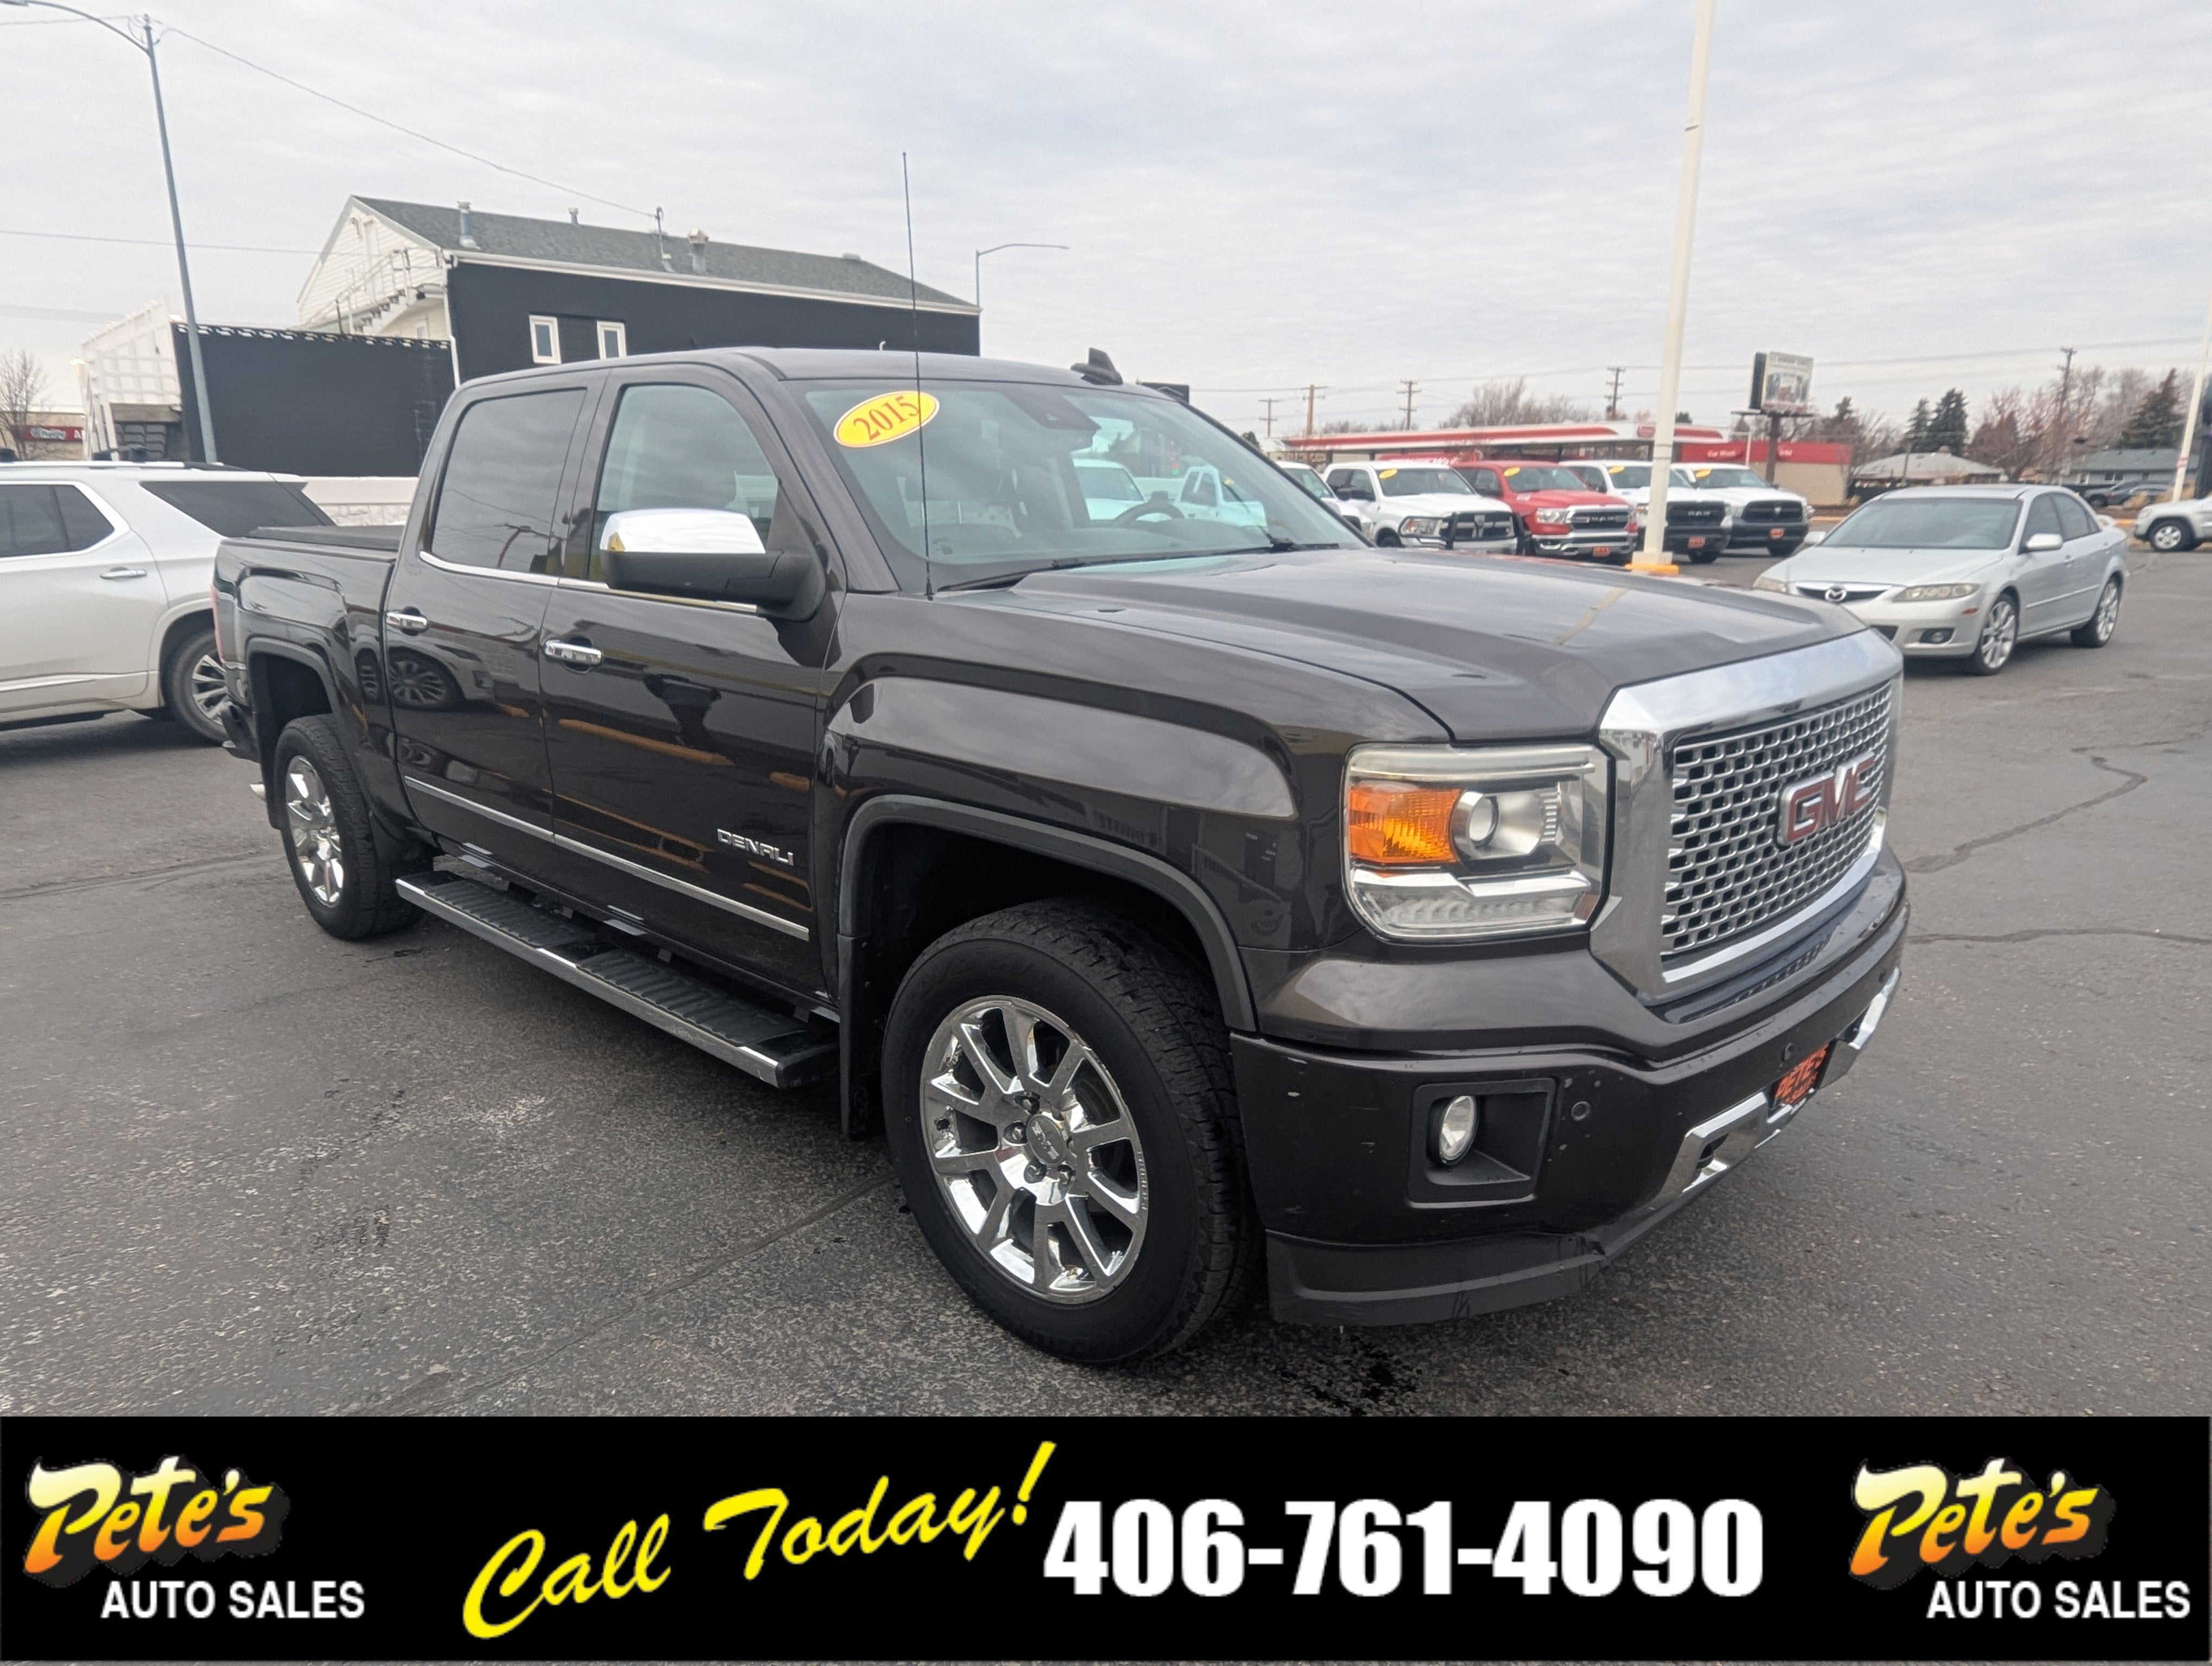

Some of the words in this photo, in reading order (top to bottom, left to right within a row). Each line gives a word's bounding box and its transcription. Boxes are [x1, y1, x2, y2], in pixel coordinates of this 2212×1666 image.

[853, 395, 920, 441] 2015
[1780, 752, 1875, 843] GMC
[717, 828, 794, 867] DENALI
